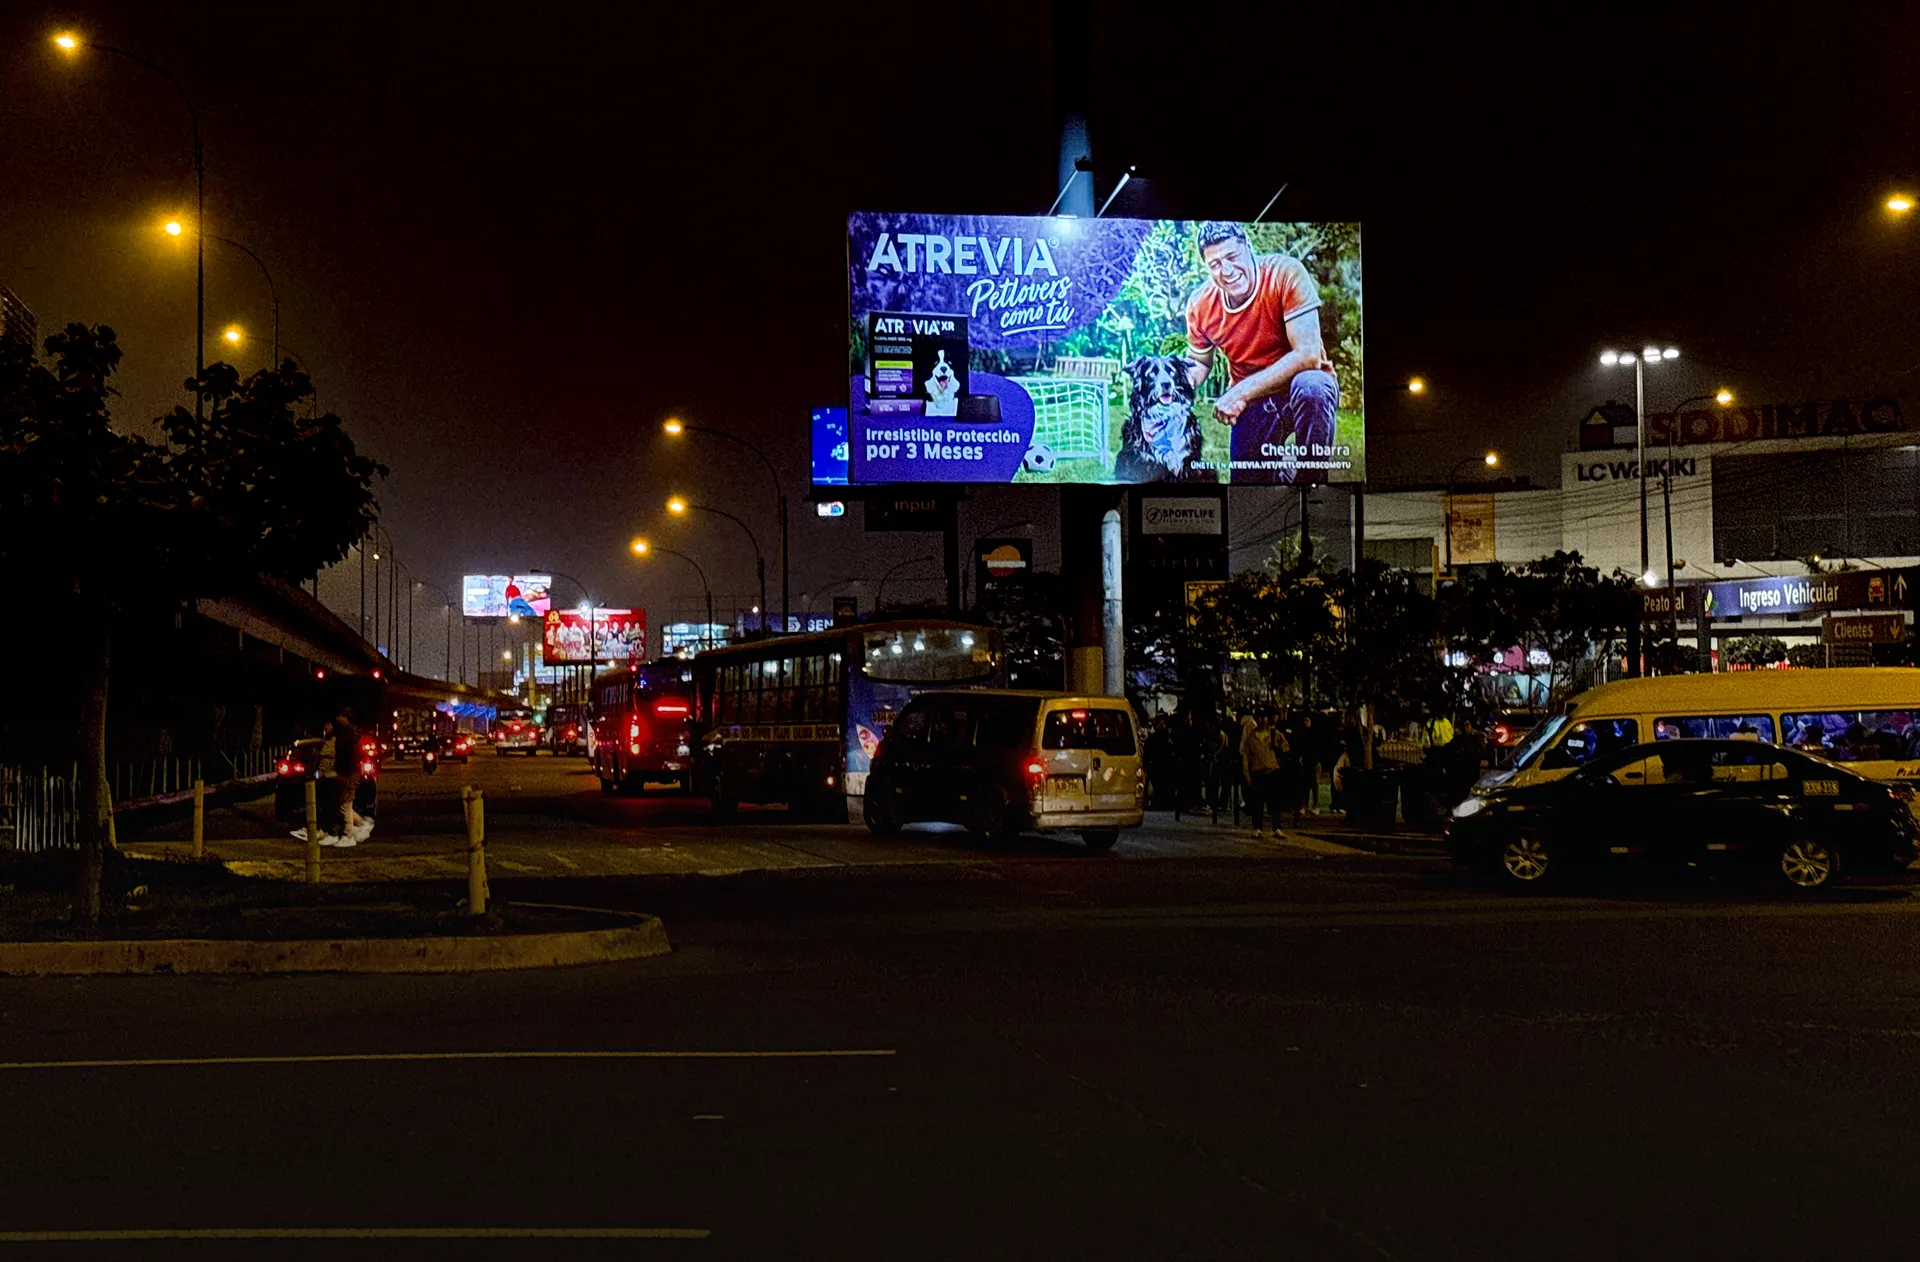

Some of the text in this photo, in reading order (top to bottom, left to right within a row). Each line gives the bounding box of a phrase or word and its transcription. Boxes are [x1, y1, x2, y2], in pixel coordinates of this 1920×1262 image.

[868, 232, 1058, 276] ATREVIA
[966, 276, 1073, 318] Petlovers
[1000, 299, 1075, 328] como tú
[866, 428, 1020, 443] Irresistible Protección
[866, 443, 983, 461] por 3 Meses
[1261, 443, 1350, 456] Checho Ibarra
[1162, 509, 1214, 518] SPORTLIFE
[1643, 591, 1685, 612] Peatoal
[1739, 581, 1839, 612] Ingreso Vehicular
[1834, 620, 1874, 639] Clientes
